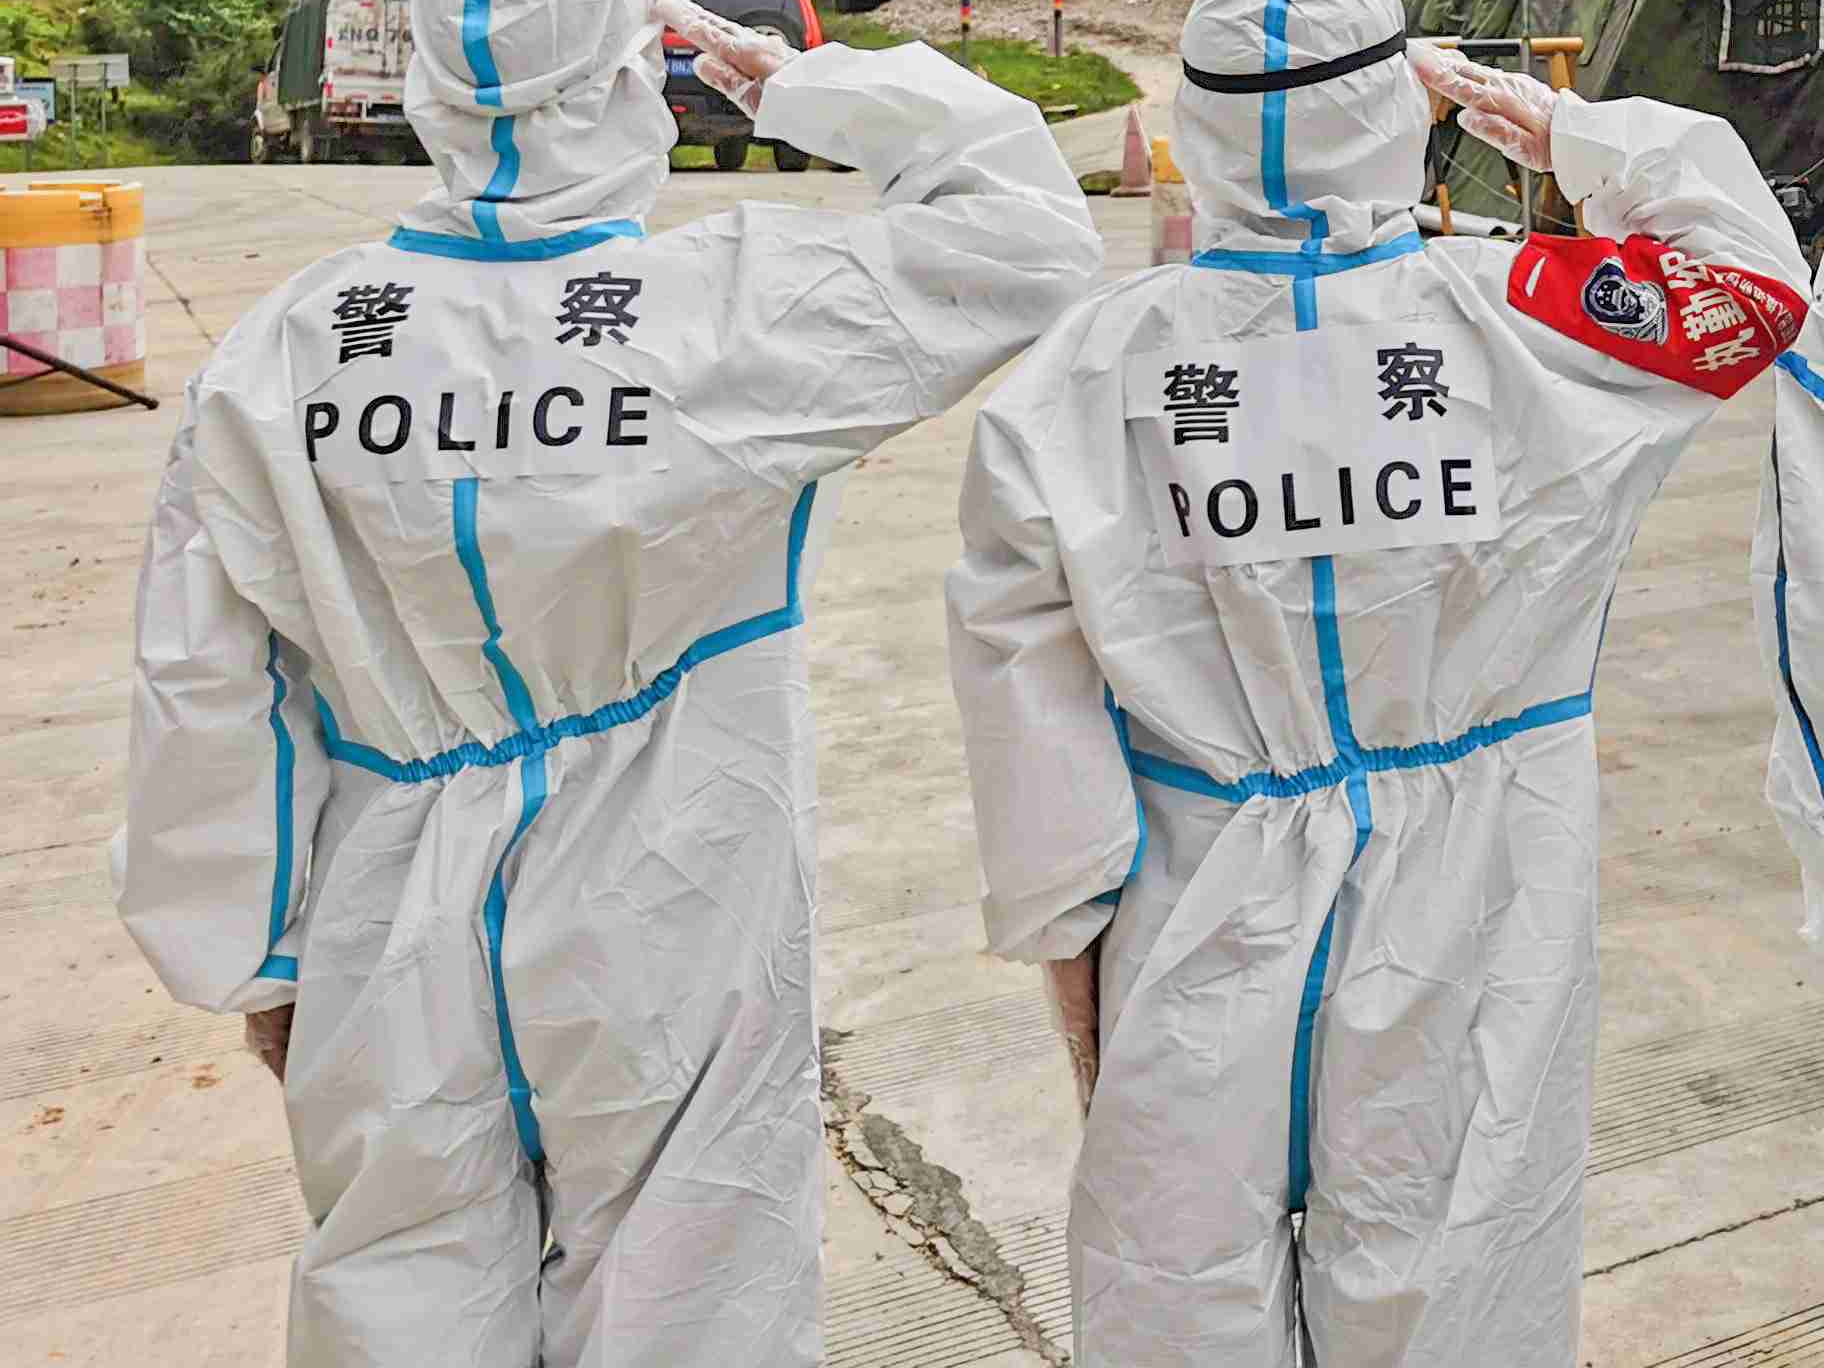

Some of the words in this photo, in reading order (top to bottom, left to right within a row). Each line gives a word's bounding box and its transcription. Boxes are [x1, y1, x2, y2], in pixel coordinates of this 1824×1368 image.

[331, 271, 643, 364] 警察
[304, 386, 652, 462] POLICE
[1163, 342, 1450, 446] 警察
[1168, 458, 1478, 538] POLICE
